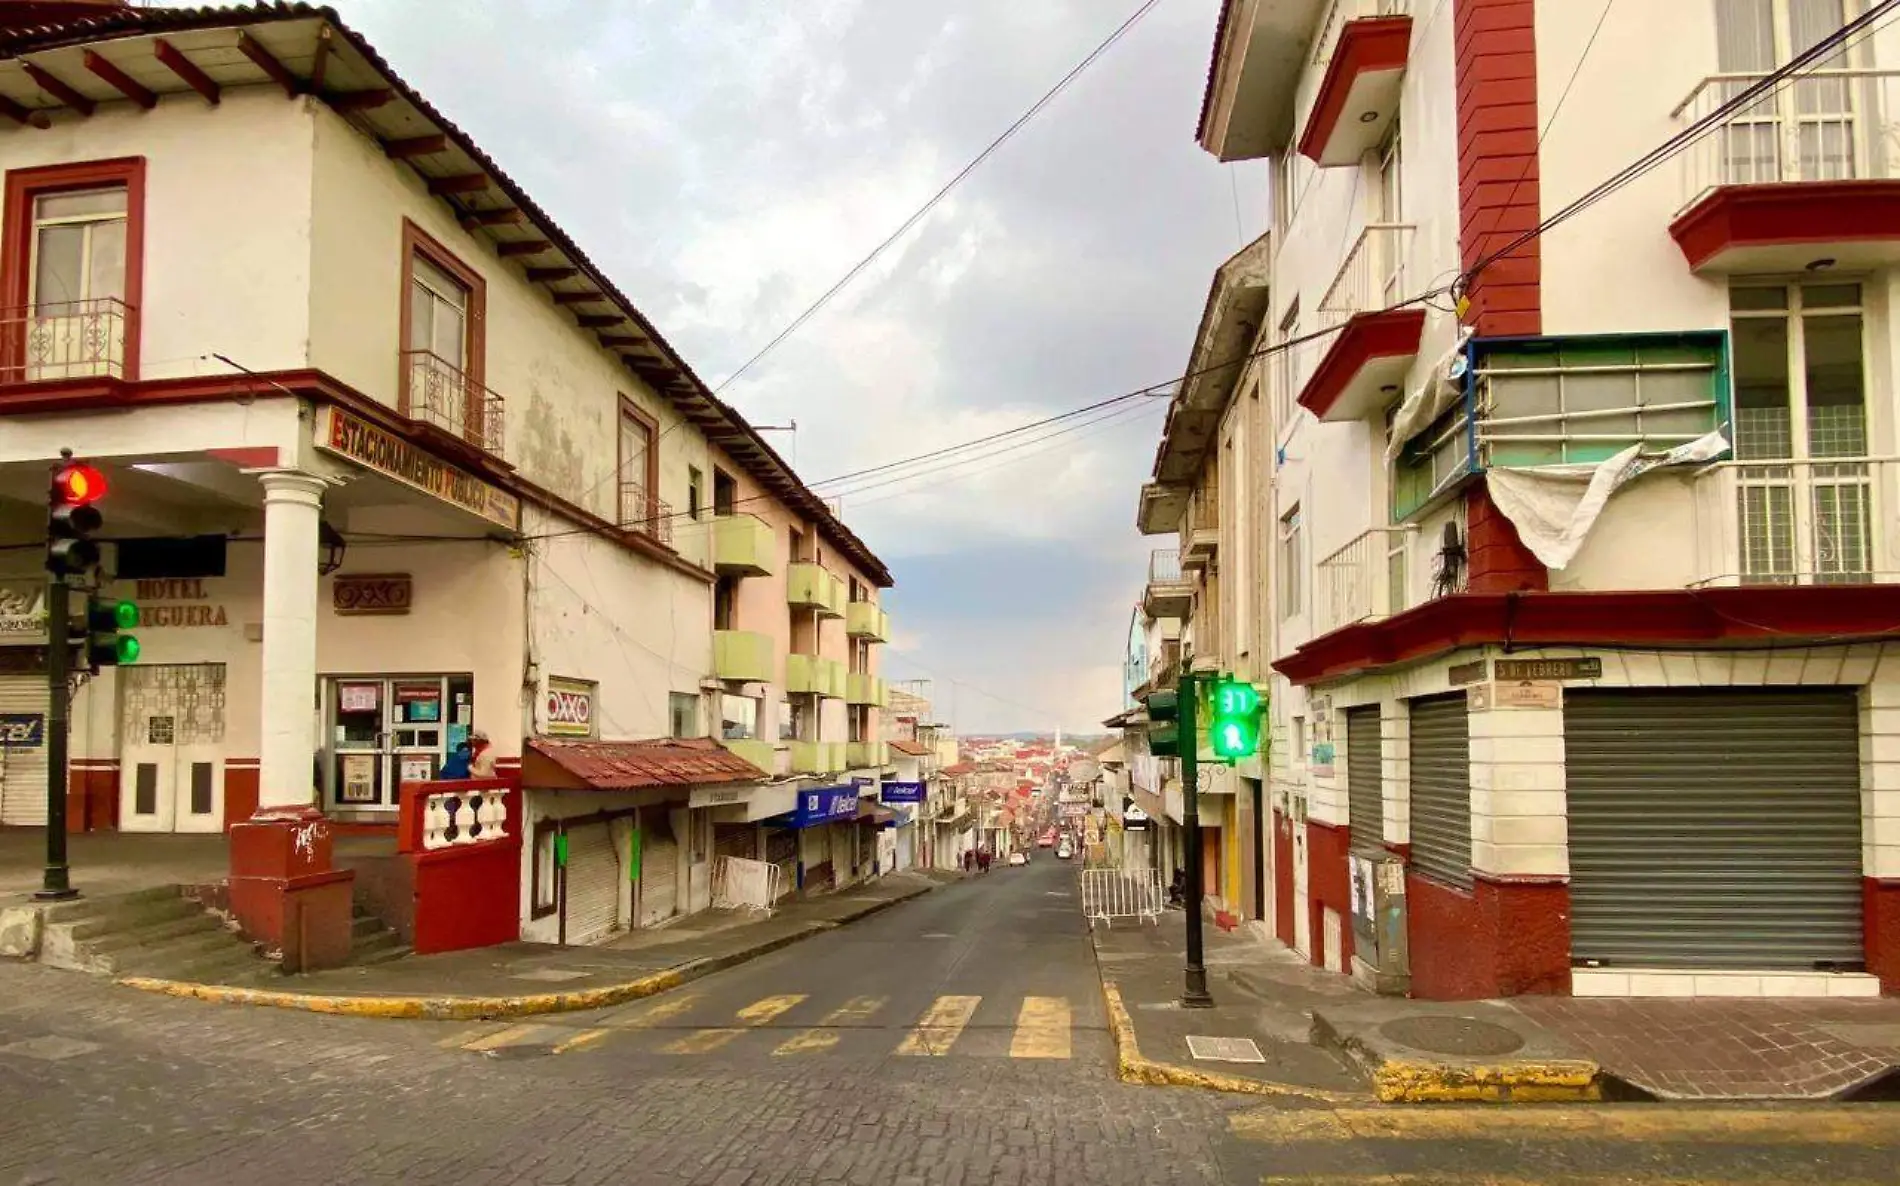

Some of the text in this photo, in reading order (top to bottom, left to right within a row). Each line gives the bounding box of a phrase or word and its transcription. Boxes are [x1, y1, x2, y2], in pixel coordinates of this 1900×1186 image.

[331, 409, 442, 496] ESTACIONAMIENTO
[136, 579, 208, 600] HOTEL
[335, 580, 411, 609] OXXO
[140, 605, 229, 628] EGUERA
[1496, 663, 1506, 676] 5
[1526, 660, 1572, 677] FEBRERO
[547, 693, 589, 723] OXXO
[893, 785, 917, 795] telcel
[835, 796, 858, 815] telcel
